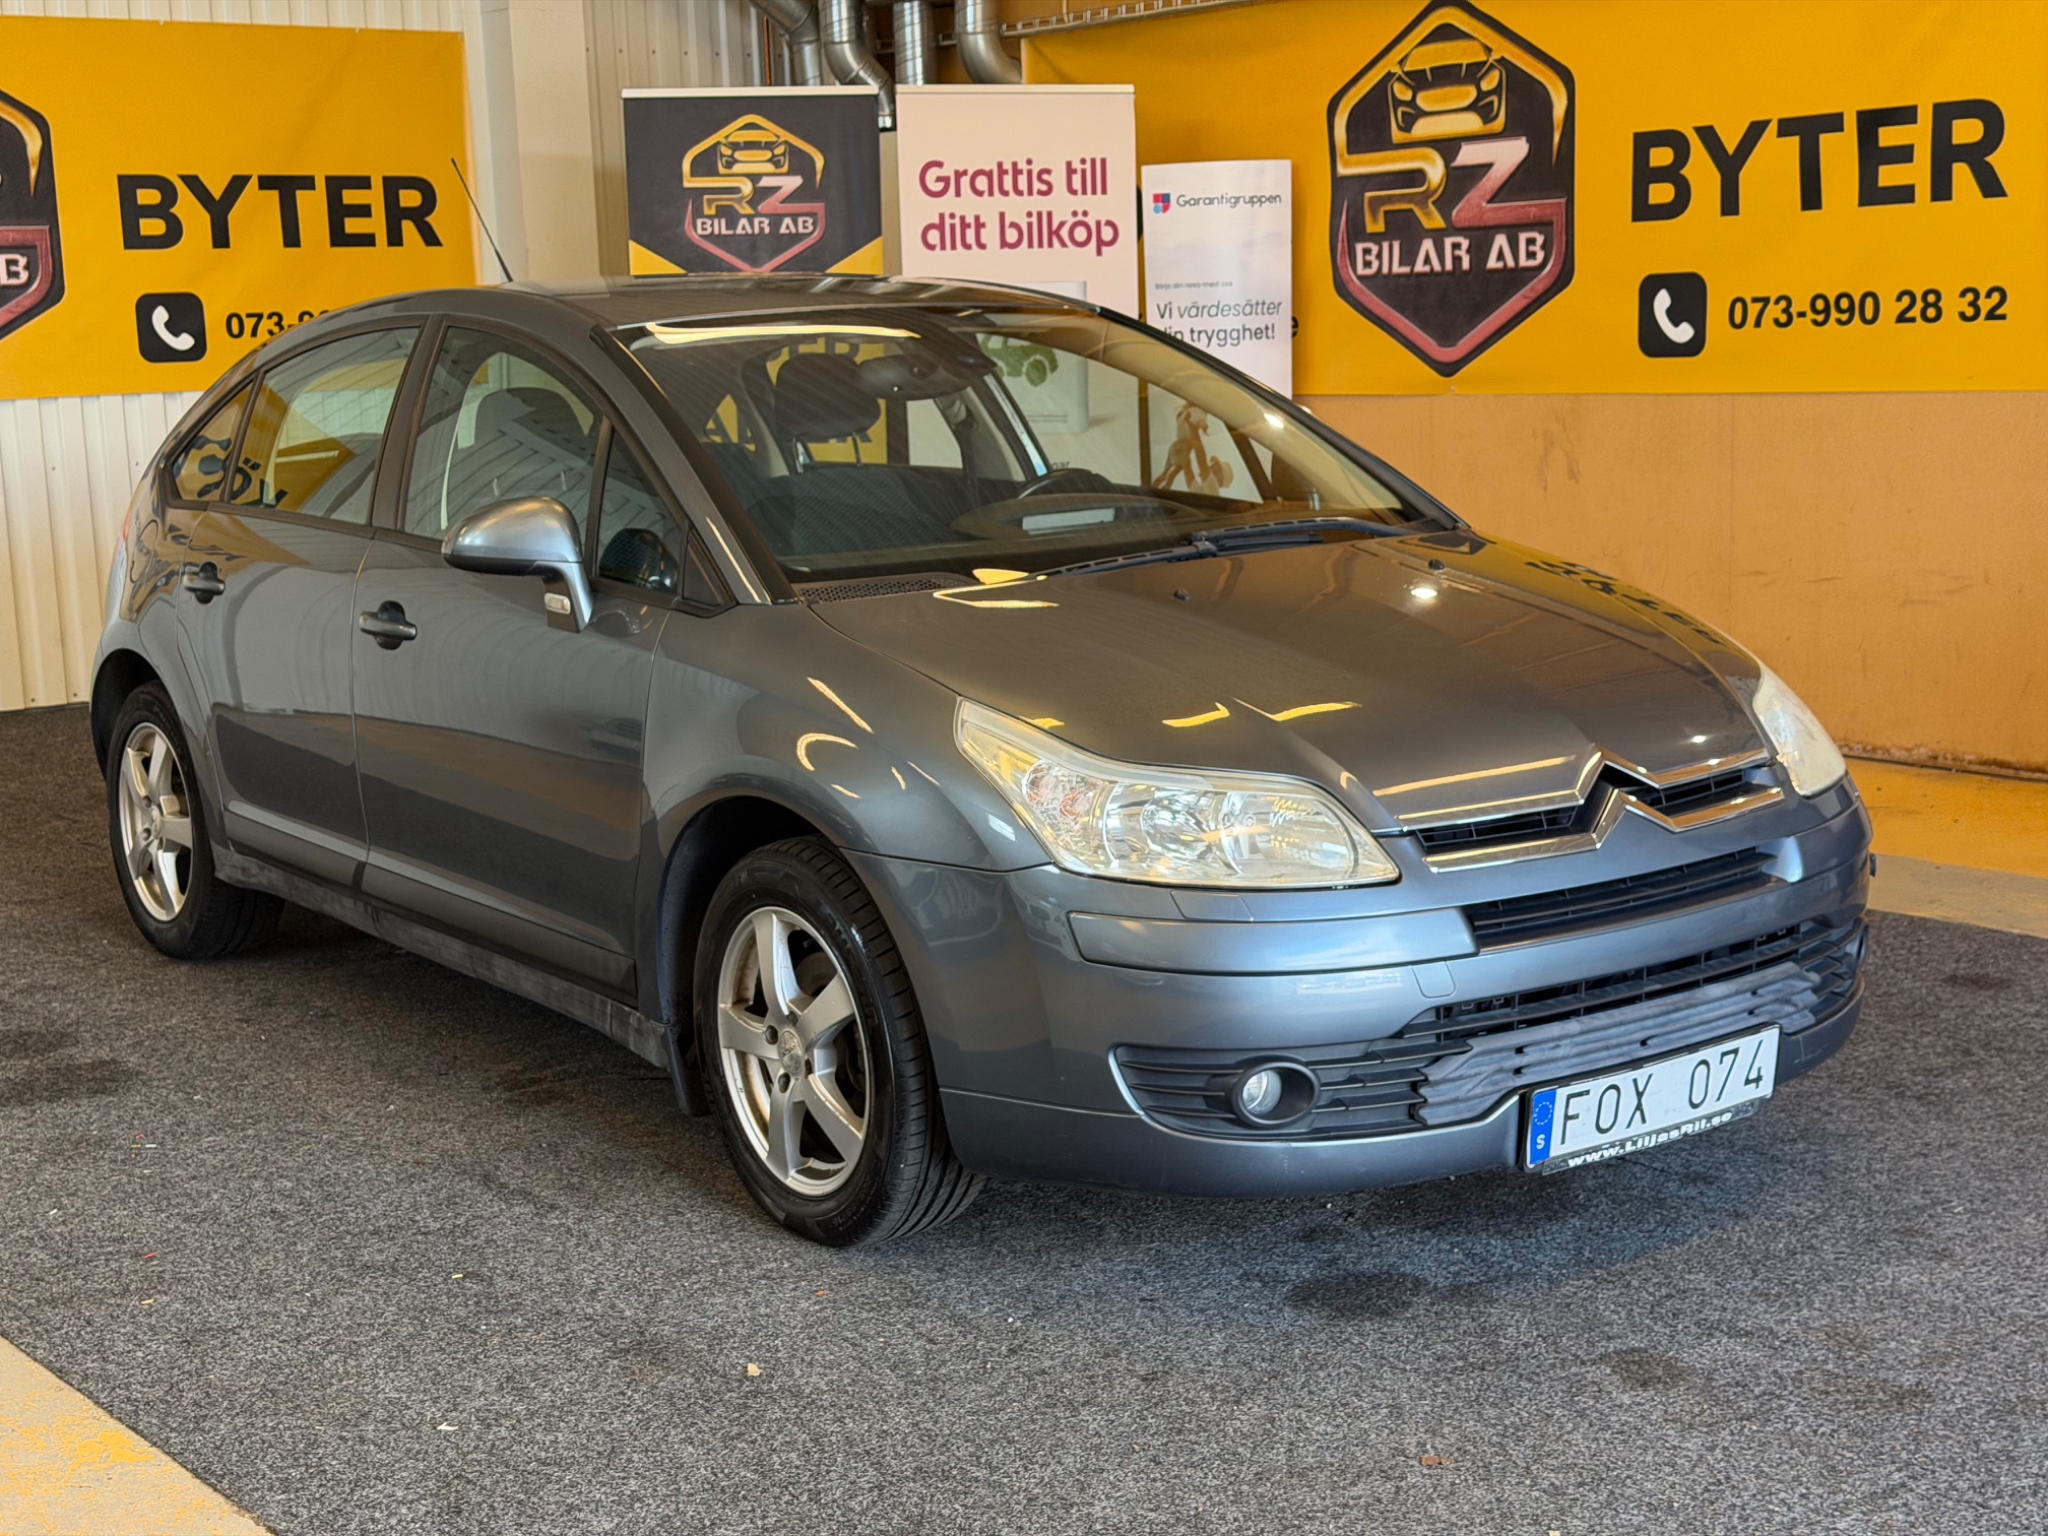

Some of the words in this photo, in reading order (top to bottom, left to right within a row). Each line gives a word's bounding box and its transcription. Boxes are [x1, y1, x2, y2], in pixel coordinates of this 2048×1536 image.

[919, 158, 1054, 198] Grattis
[1065, 157, 1108, 196] till
[1631, 98, 2009, 222] BYTER
[682, 175, 826, 216] RZ
[1176, 192, 1283, 209] Garantigruppen
[1337, 137, 1567, 234] RZ
[117, 174, 444, 250] BYTER
[696, 217, 770, 235] BILAR
[779, 217, 814, 234] AB
[921, 212, 987, 251] ditt
[999, 209, 1119, 257] bilköp
[1355, 236, 1470, 276] BILAR
[1486, 231, 1545, 271] AB
[1156, 301, 1173, 319] Vi
[1177, 299, 1282, 319] värdesätter
[1728, 290, 1881, 329] 073-990
[1895, 288, 1943, 324] 28
[1958, 285, 2008, 322] 32
[1190, 323, 1275, 348] trygghet!
[1561, 1073, 1653, 1146] FOX
[1688, 1039, 1764, 1109] 074
[1536, 1133, 1546, 1150] S
